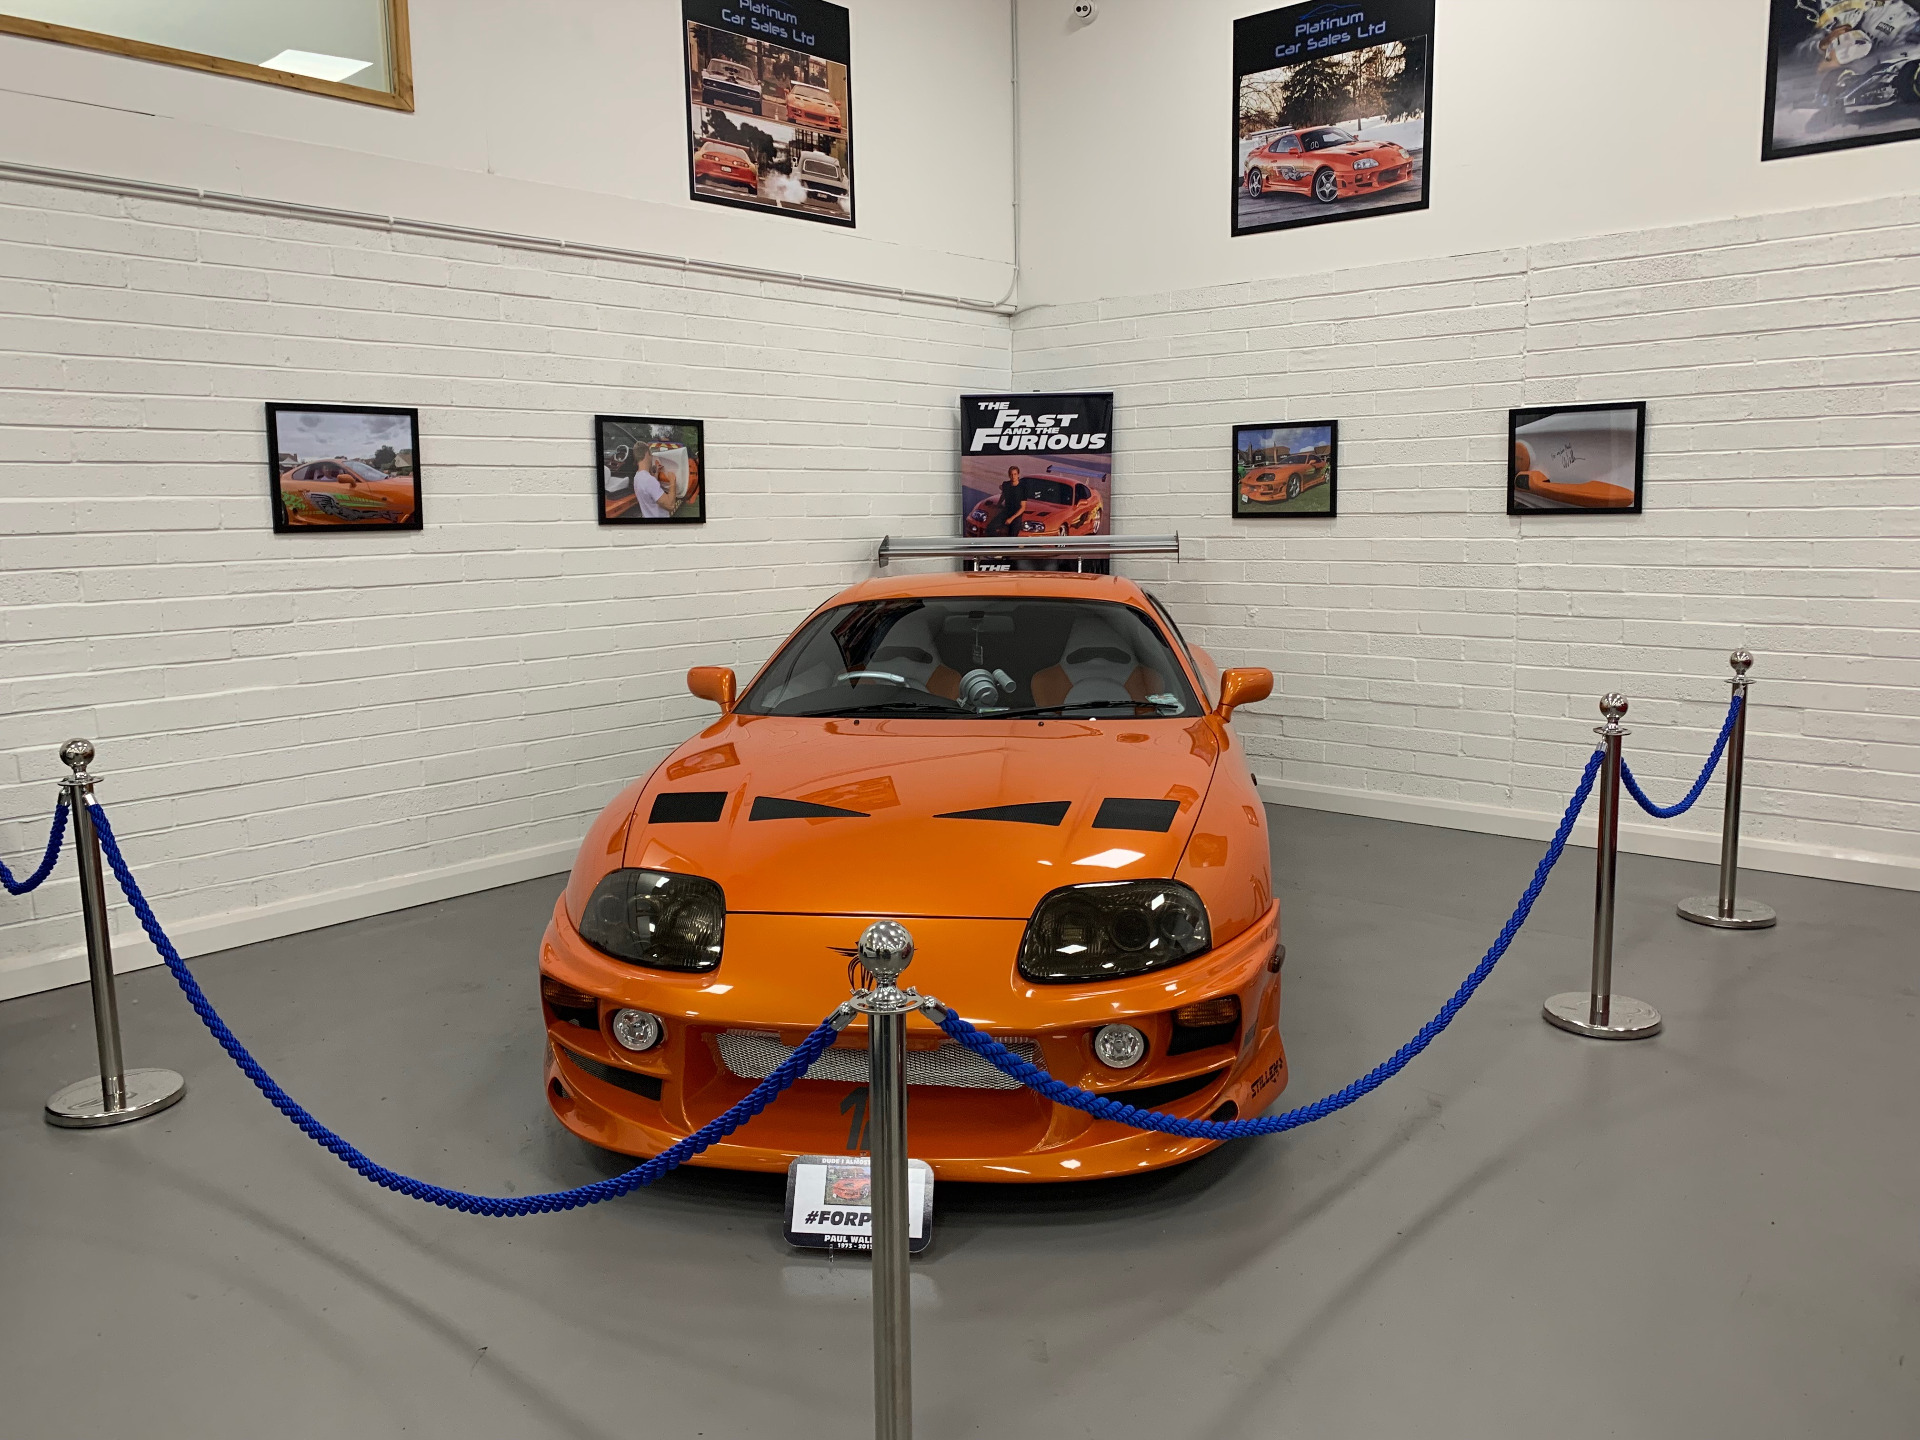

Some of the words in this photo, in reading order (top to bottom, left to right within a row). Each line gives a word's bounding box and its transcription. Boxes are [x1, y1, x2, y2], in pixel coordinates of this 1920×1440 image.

[739, 0, 798, 25] Platinum
[721, 8, 746, 26] Car
[751, 17, 788, 38] Sales
[792, 29, 815, 46] Ltd
[1295, 12, 1364, 37] Platinum
[1275, 43, 1302, 58] Car
[1306, 32, 1351, 51] Sales
[1357, 20, 1386, 38] Ltd
[978, 401, 1010, 411] THE
[993, 409, 1079, 428] FAST
[970, 427, 1107, 451] FURIOUS
[1003, 427, 1031, 435] AND
[979, 564, 1011, 572] THE
[804, 1210, 872, 1227] #FORP
[823, 1234, 848, 1243] PAUL
[850, 1235, 873, 1244] WAL
